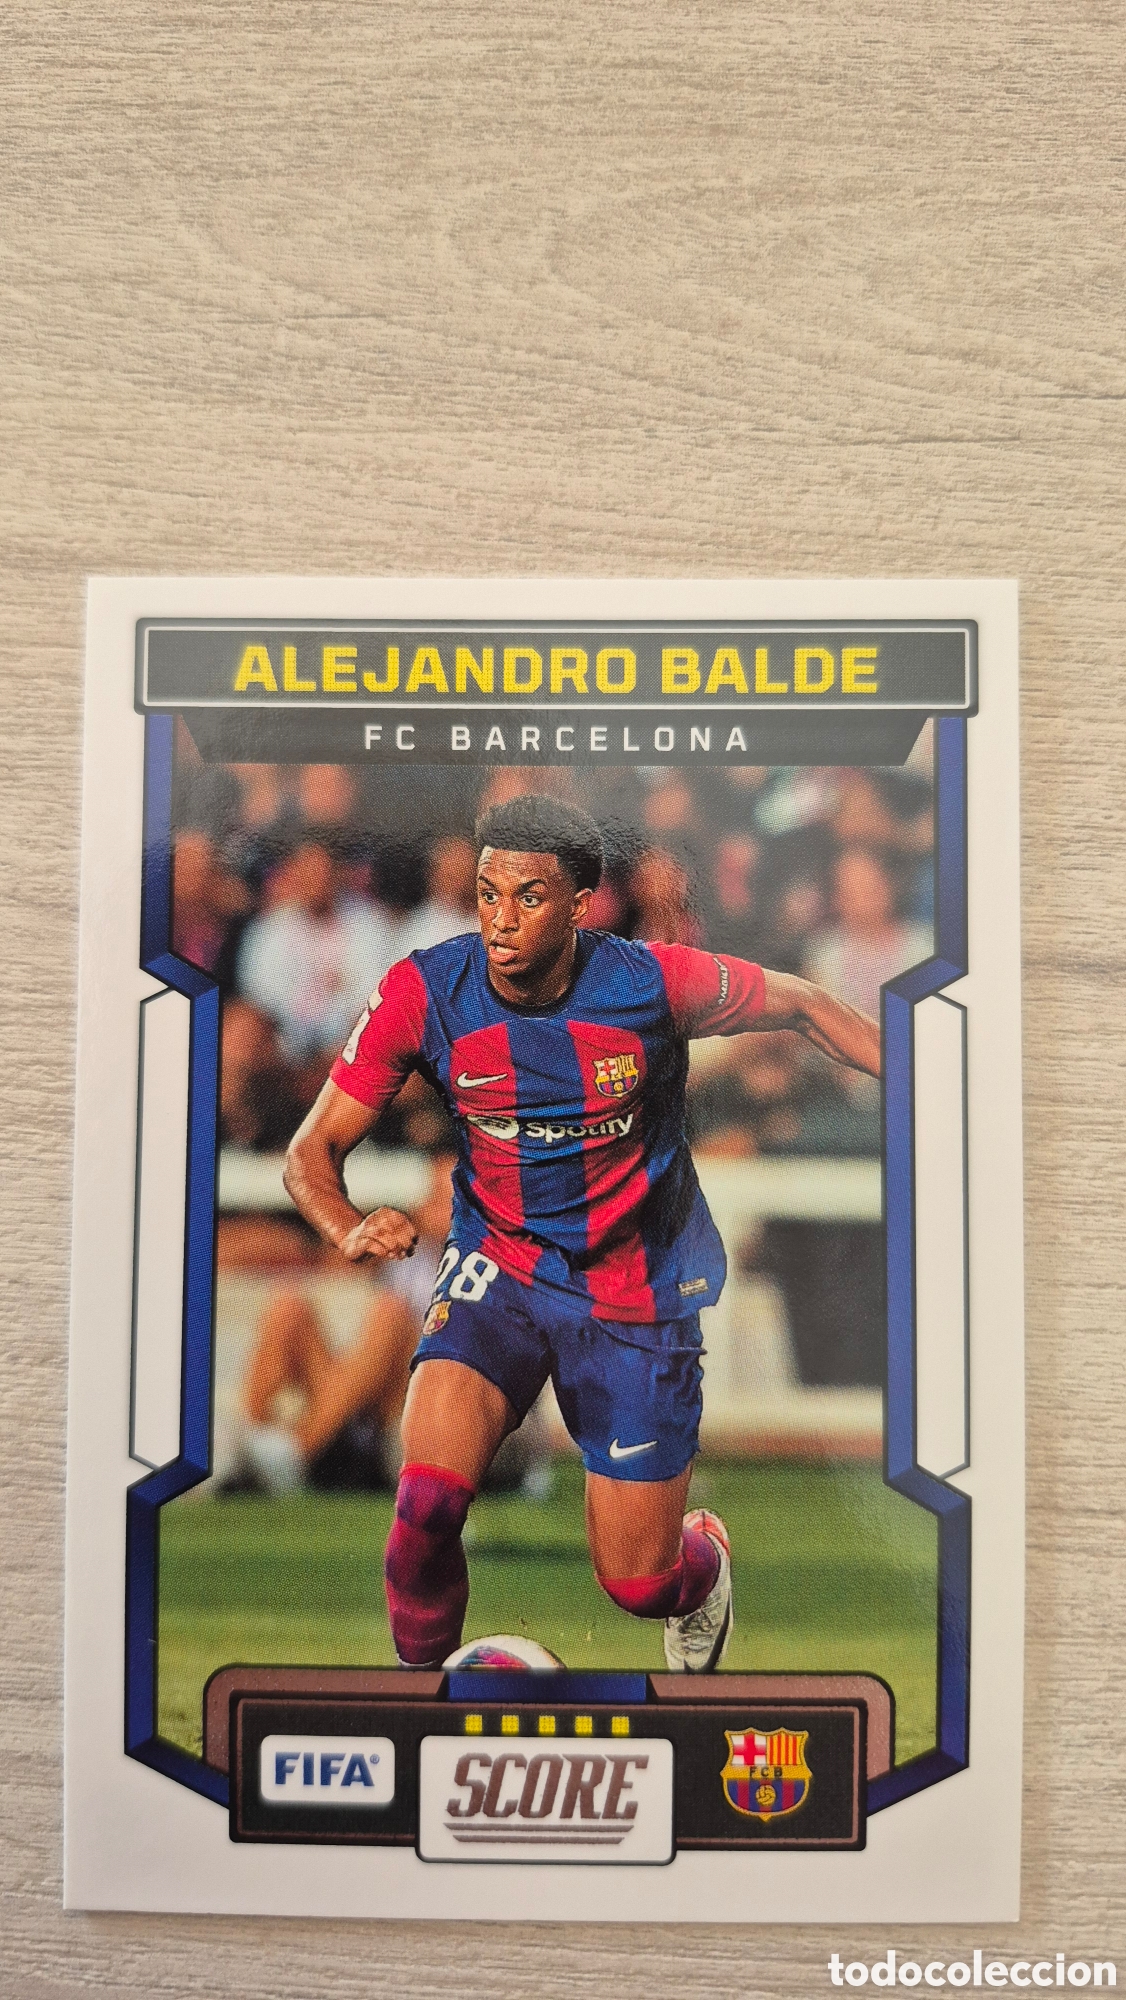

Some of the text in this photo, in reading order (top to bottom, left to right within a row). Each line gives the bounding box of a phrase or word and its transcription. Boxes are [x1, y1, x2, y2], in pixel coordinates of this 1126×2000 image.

[234, 646, 878, 693] ALEJANDRO BALDE
[364, 725, 748, 752] FC BARCELONA
[447, 1752, 649, 1820] SCORE
